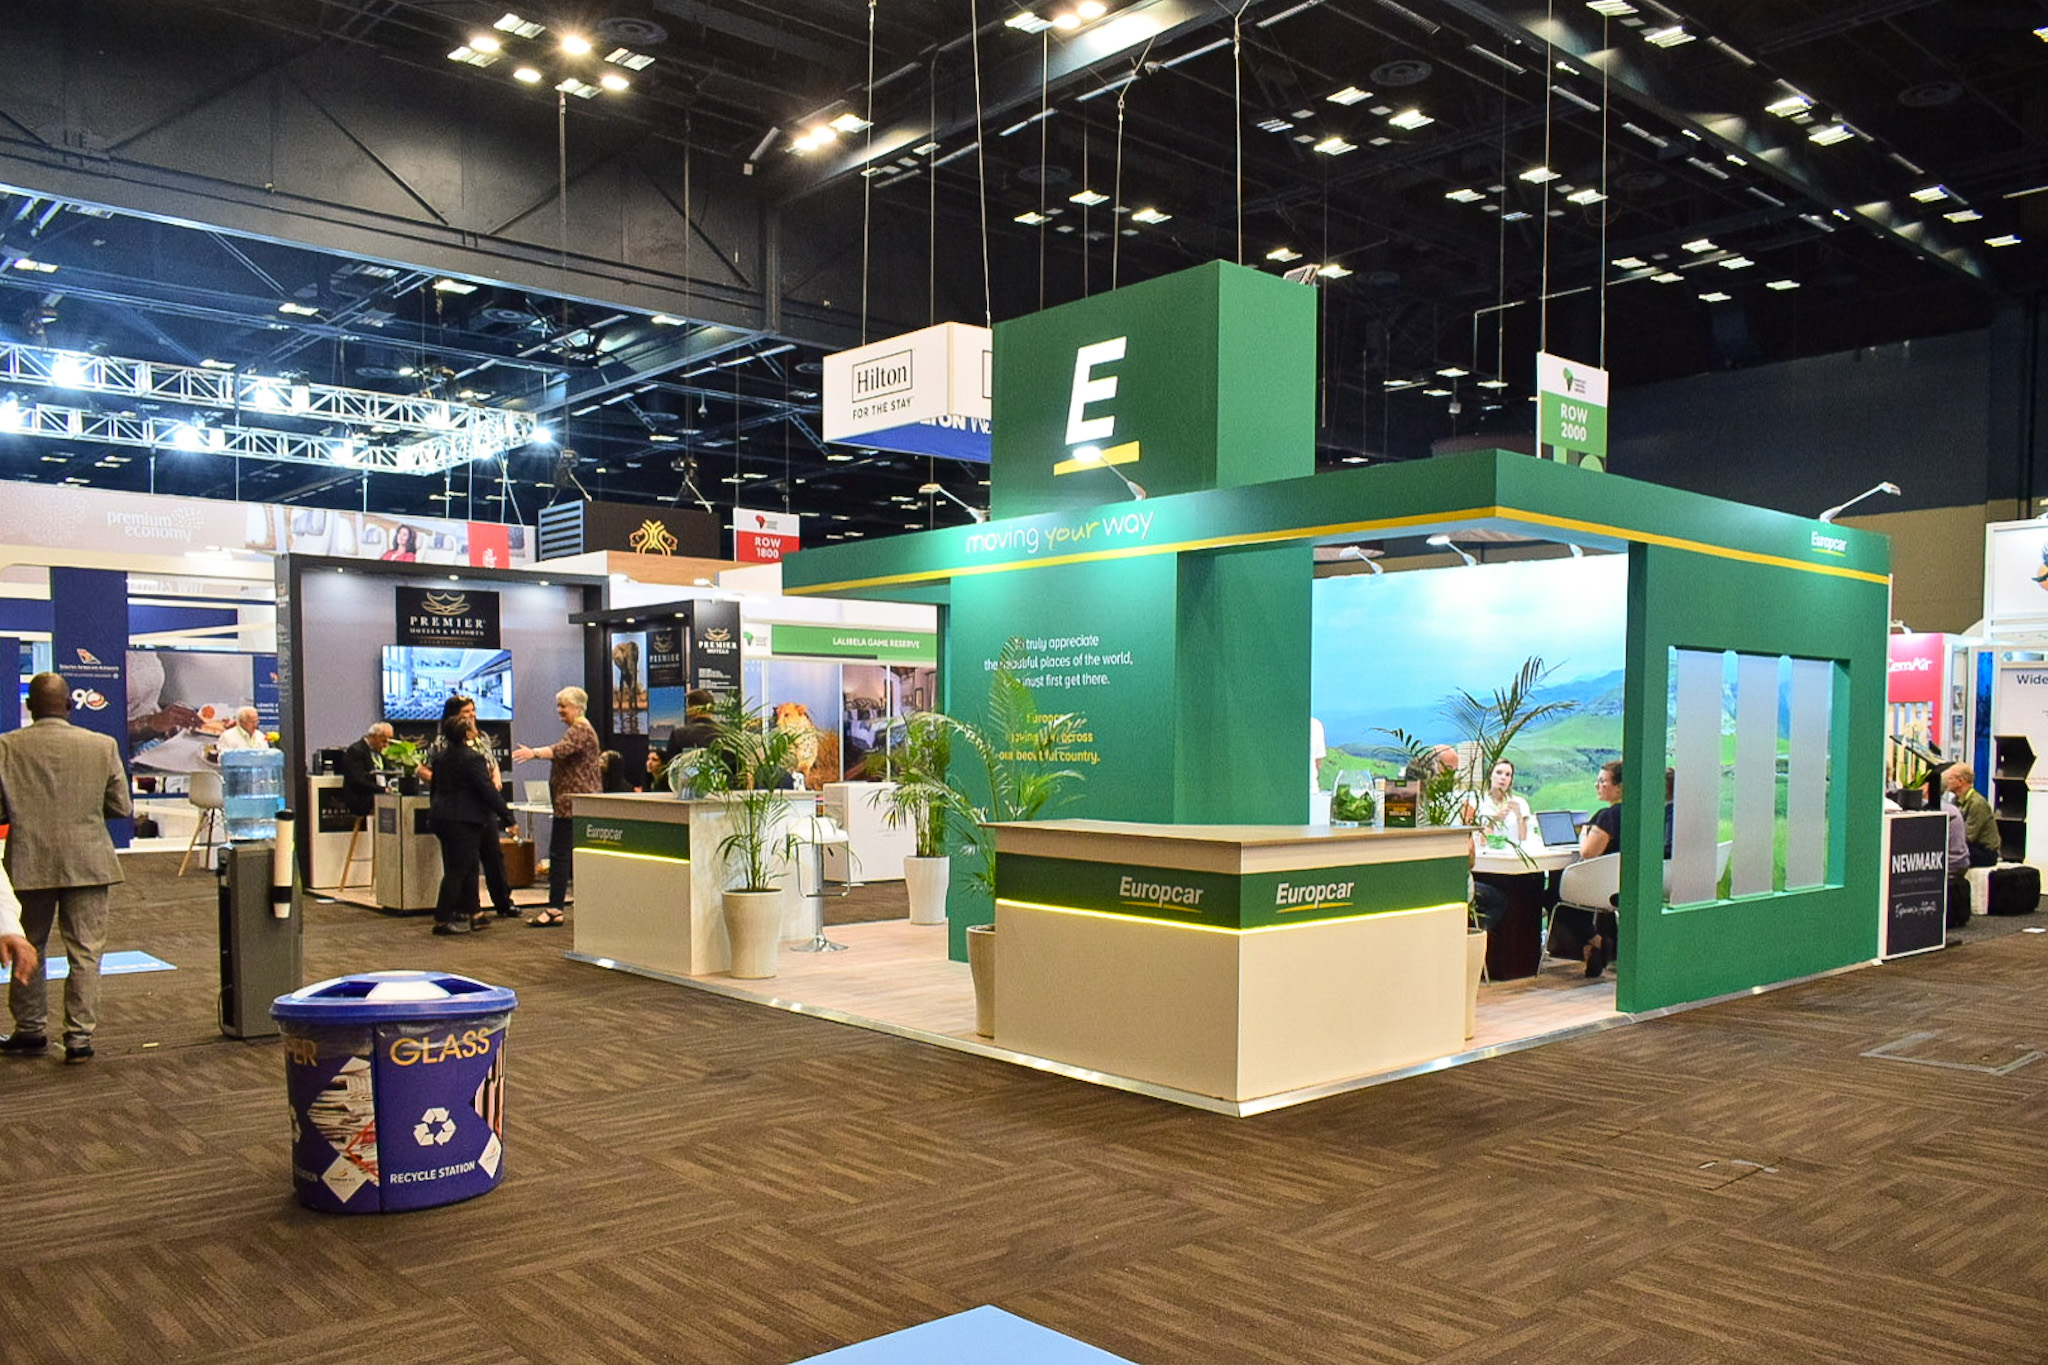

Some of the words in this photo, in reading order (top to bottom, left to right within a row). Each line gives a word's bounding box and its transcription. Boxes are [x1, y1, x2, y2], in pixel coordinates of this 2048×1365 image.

[857, 365, 907, 393] Hilton
[1065, 336, 1127, 445] E
[853, 407, 869, 420] FOR
[872, 401, 888, 415] THE
[891, 397, 913, 411] STAY
[1560, 403, 1588, 424] ROW
[1560, 421, 1587, 442] 2000
[106, 511, 173, 527] premium
[124, 525, 192, 542] economy
[966, 527, 1039, 554] moving
[1044, 521, 1100, 550] your
[1102, 510, 1154, 540] way
[1811, 531, 1848, 552] Europcar
[754, 536, 781, 548] ROW
[756, 547, 780, 559] 1800
[409, 616, 484, 629] PREMIER
[698, 641, 738, 650] PREMIER
[867, 638, 888, 648] GAME
[1026, 637, 1048, 652] truly
[1048, 634, 1100, 652] appreciate
[984, 659, 998, 671] the
[1040, 655, 1071, 671] places
[1072, 653, 1083, 666] of
[1084, 652, 1100, 666] the
[1045, 673, 1063, 687] first
[1064, 674, 1080, 689] get
[1082, 671, 1111, 686] there.
[1061, 732, 1093, 744] across
[1059, 749, 1100, 765] country.
[586, 824, 623, 842] Europcar
[1892, 851, 1944, 874] NEWMARK
[1120, 875, 1204, 908] Europcar
[1276, 879, 1355, 909] Europcar
[389, 1027, 491, 1067] GLASS
[390, 1169, 437, 1184] RECYCLE
[438, 1160, 476, 1179] STATION
